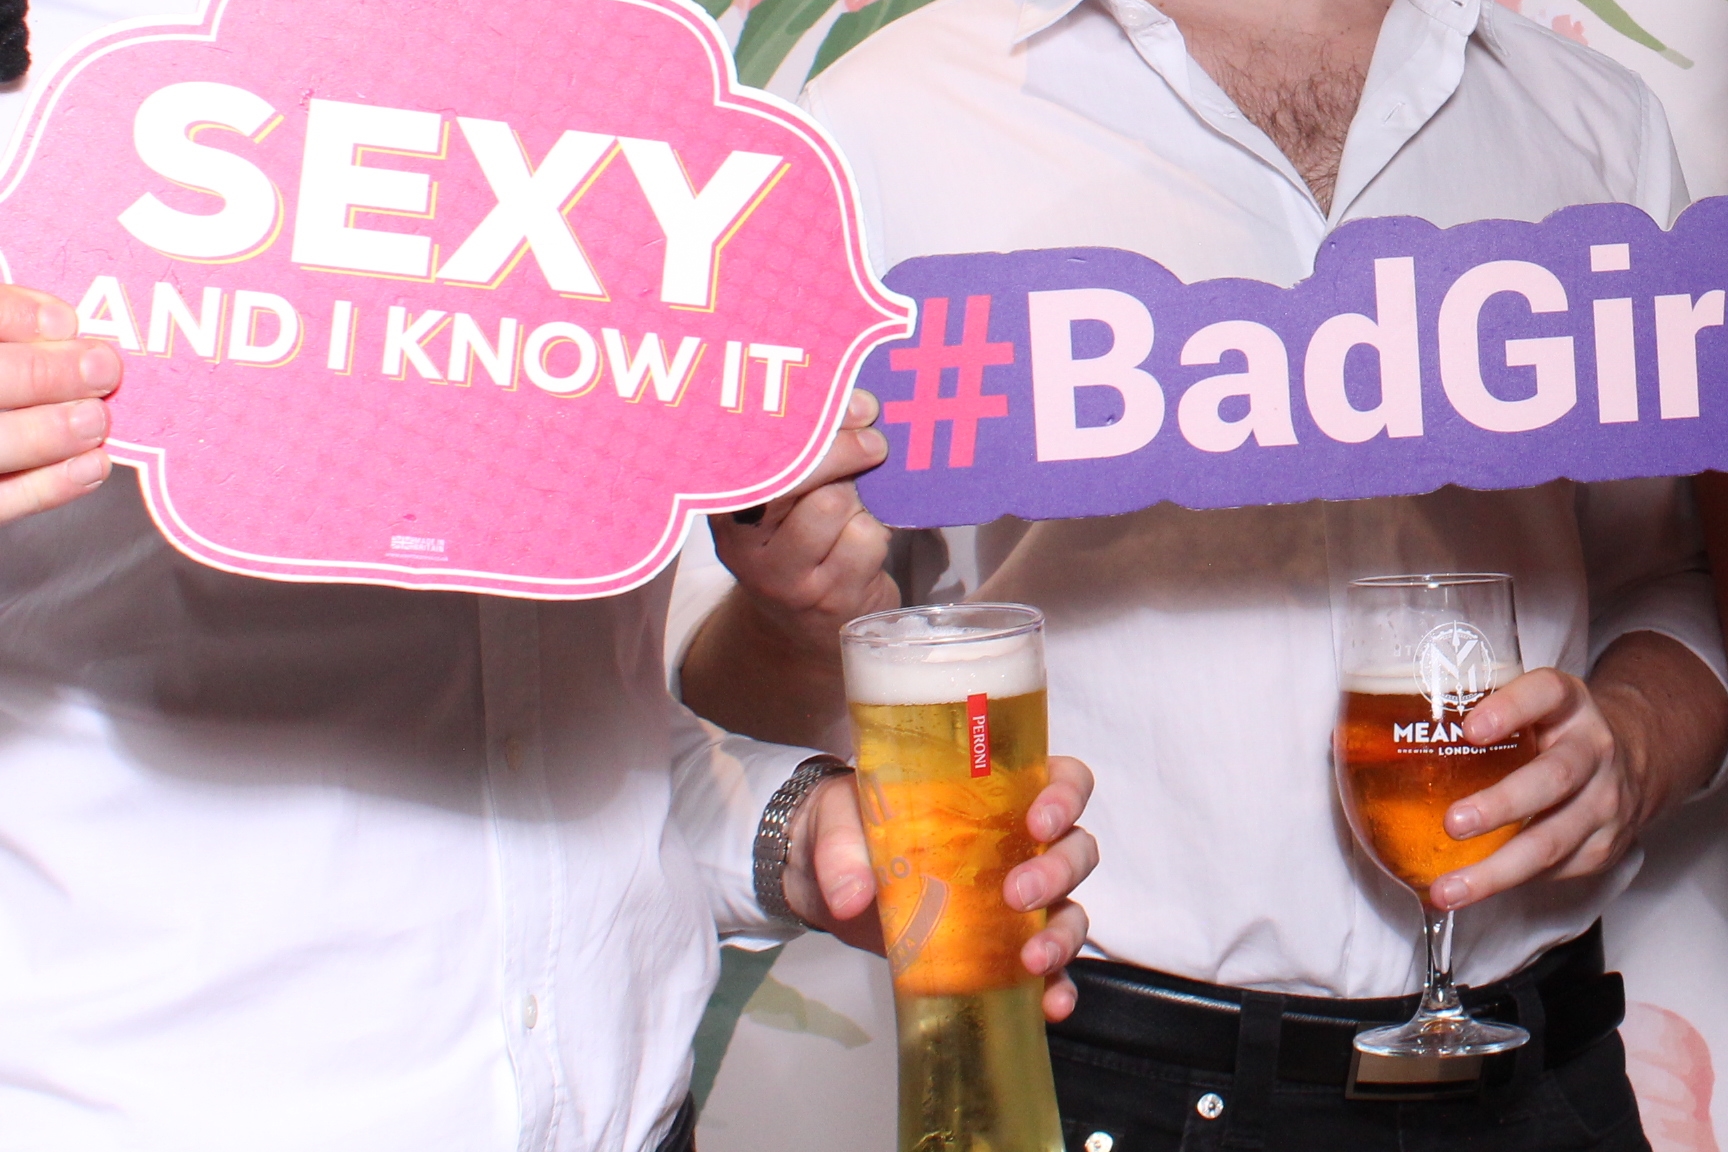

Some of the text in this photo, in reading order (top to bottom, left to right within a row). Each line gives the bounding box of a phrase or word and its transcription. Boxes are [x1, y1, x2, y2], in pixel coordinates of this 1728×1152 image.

[117, 80, 792, 312] SEXY
[76, 275, 809, 418] AND I KNOW IT
[972, 715, 987, 769] PERONI
[1438, 746, 1487, 756] LONDON
